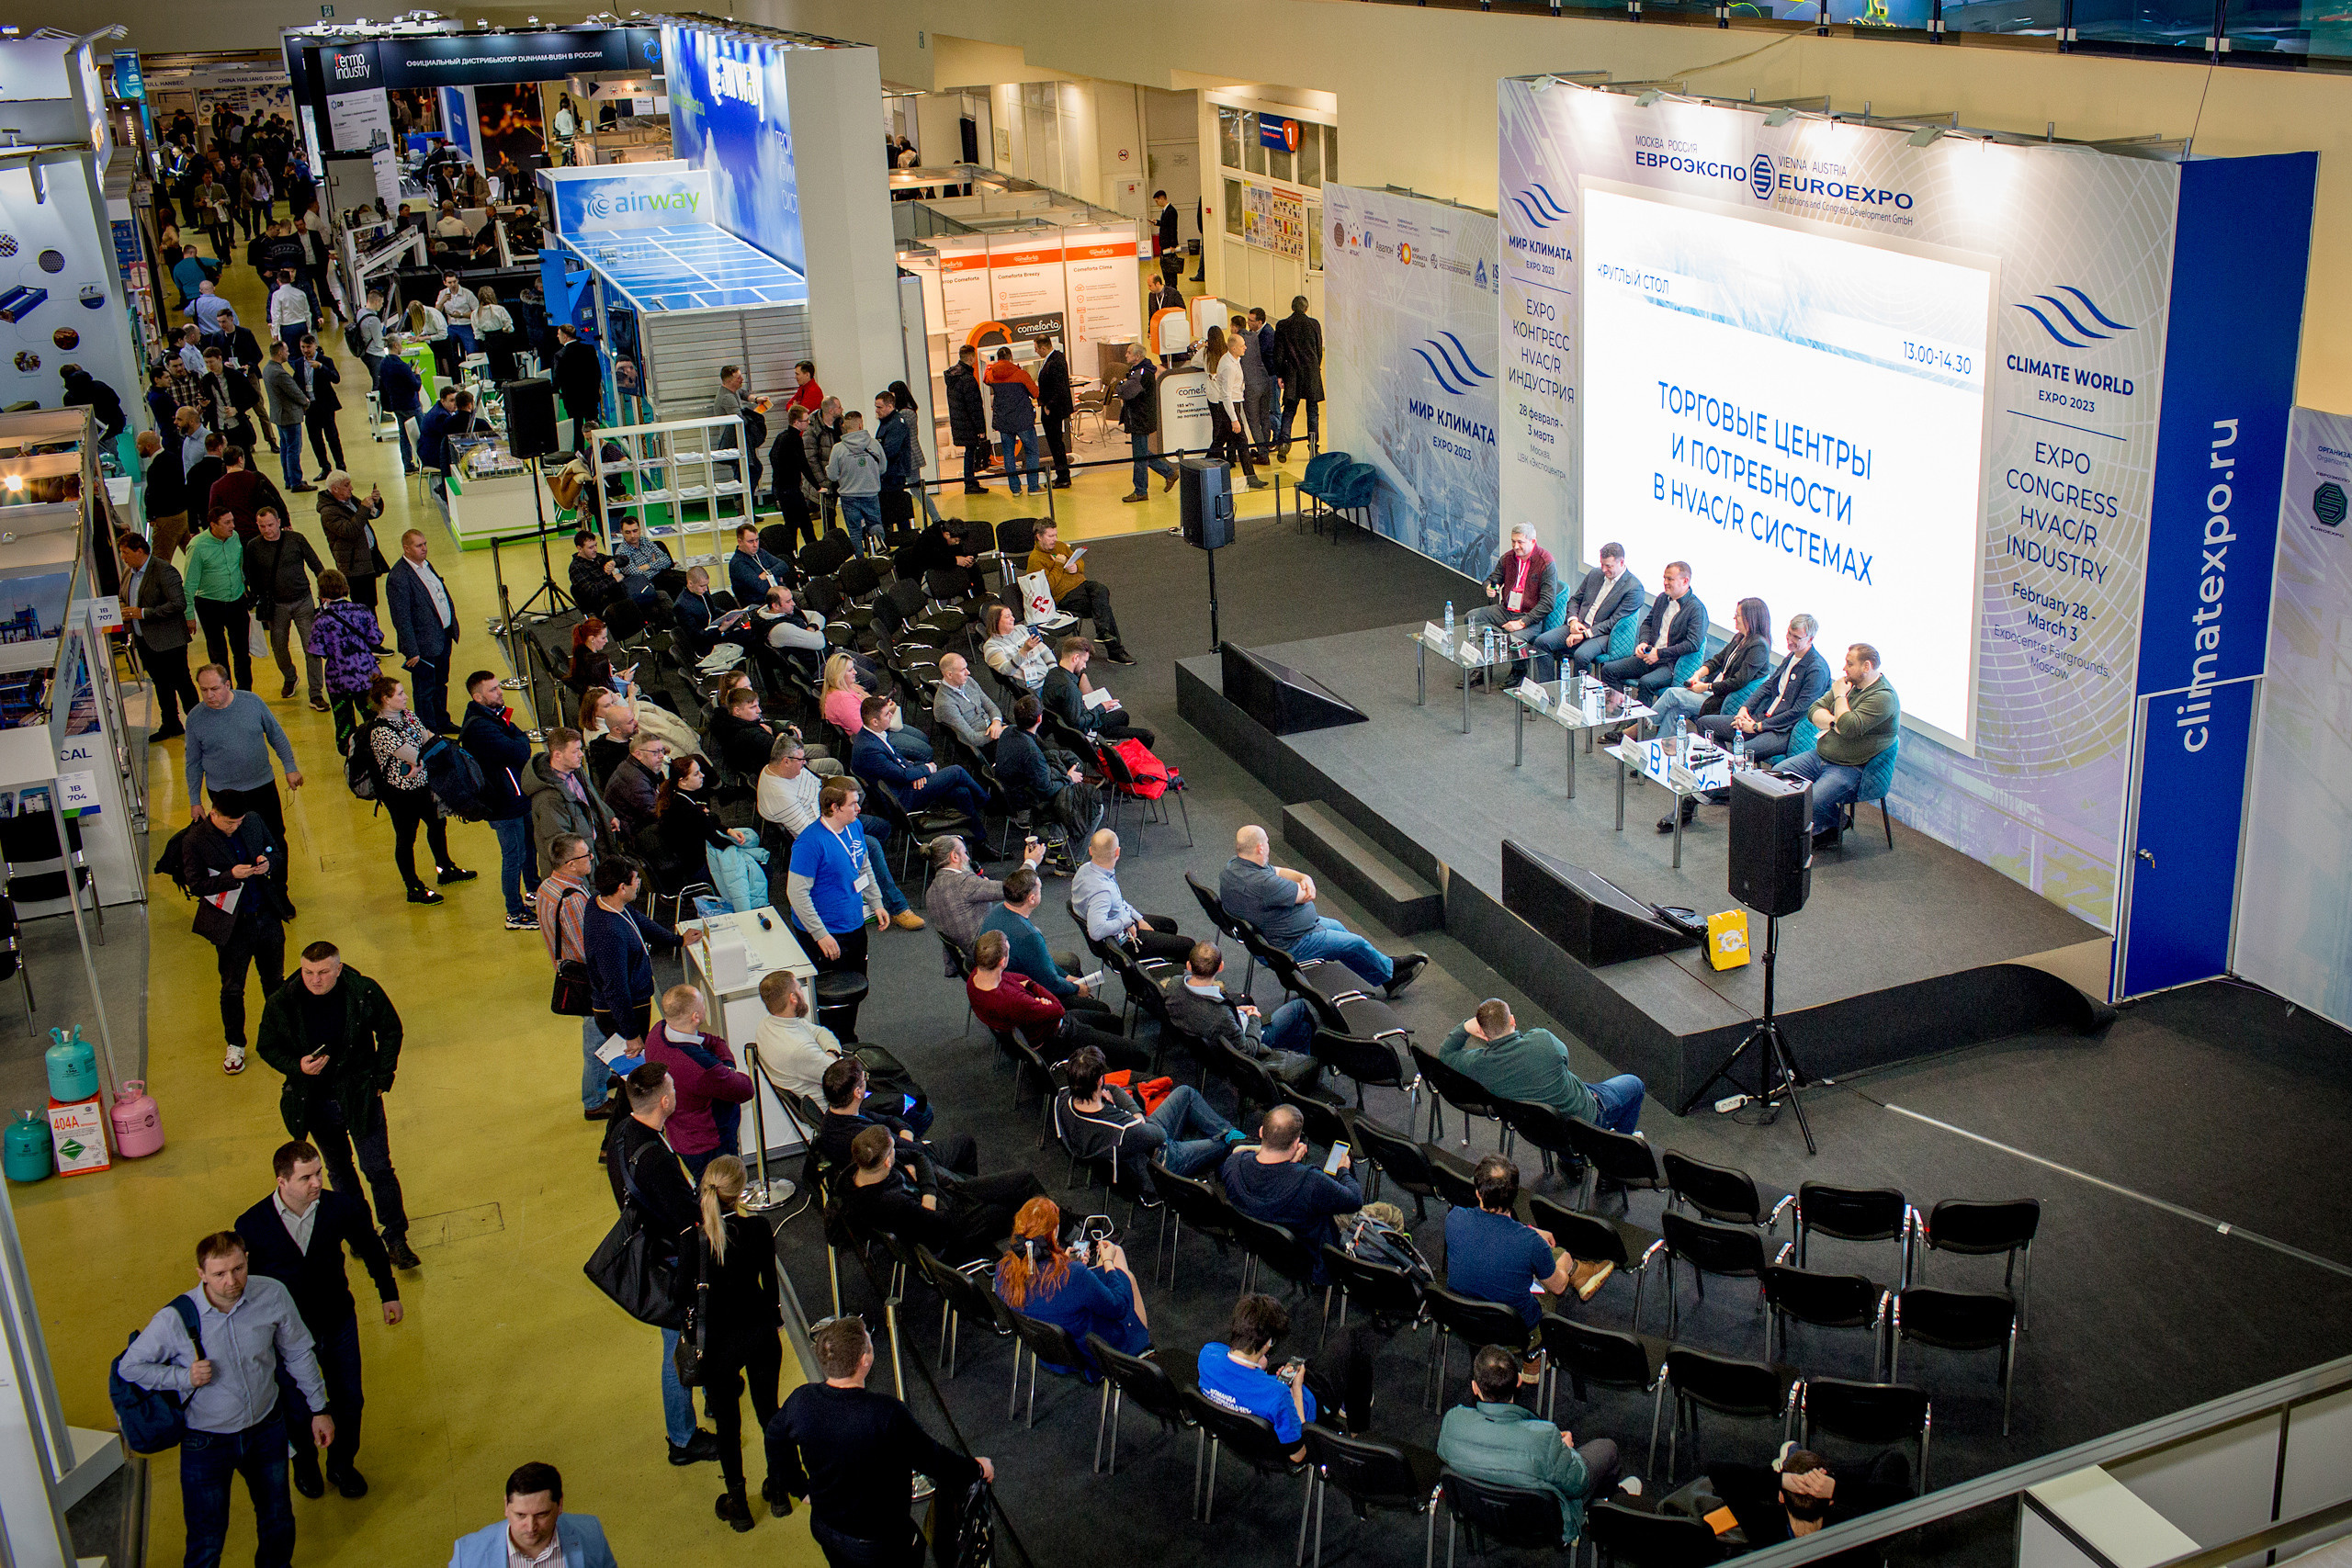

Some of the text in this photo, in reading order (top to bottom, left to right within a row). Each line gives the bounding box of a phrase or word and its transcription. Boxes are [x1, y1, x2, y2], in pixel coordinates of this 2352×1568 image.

[334, 53, 365, 68] termo
[335, 64, 370, 80] industry
[406, 57, 460, 67] ОФИЦИАЛЬНЫЙ
[461, 56, 517, 66] ДИСТРИБЬЮТОР
[518, 52, 567, 62] DUNHAM-BUSH
[1288, 127, 1292, 145] 1
[1635, 135, 1698, 153] МОСКВА РОССИЯ
[1635, 151, 1747, 182] ЕВРОЭКСПО
[1778, 155, 1848, 177] VIENNA AUSTRIA
[615, 191, 700, 213] airway
[1778, 174, 1914, 209] EUROEXPO
[1778, 193, 1914, 226] Exhibitions and Congress Development GmbH
[1509, 235, 1573, 262] МИР КЛИМАТА
[1526, 260, 1555, 275] EXPO 2023
[1597, 262, 1669, 294] КРУГЛЫЙ СТОЛ
[1527, 299, 1555, 321] EXPO
[1016, 319, 1061, 333] comeforta
[1513, 319, 1570, 351] КОНГРЕСС
[1521, 346, 1561, 374] HVAC/R
[1903, 341, 1972, 375] 13.00-14.30
[1509, 367, 1575, 404] ИНДУСТРИЯ
[2007, 354, 2134, 396] CLIMATE WORLD
[2038, 389, 2095, 412] EXPO 2023
[1409, 397, 1496, 447] МИР КЛИМАТА
[1519, 403, 1528, 416] 28
[1528, 407, 1559, 428] февраля
[1527, 424, 1555, 444] 3 марта
[1658, 380, 1871, 480] ТОРГОВЫЕ ЦЕНТРЫ
[1432, 436, 1472, 461] EXPO 2023
[1530, 444, 1551, 461] Москва,
[2035, 441, 2091, 475] EXPO
[1672, 432, 1852, 526] И ПОТРЕБНОСТИ
[2316, 471, 2351, 484] ЕВРОЭКСПО
[2006, 468, 2118, 518] CONGRESS
[1654, 472, 1873, 586] В HVAC/R СИСТЕМАХ
[2020, 505, 2098, 548] HVAC/R
[2310, 525, 2345, 538] EUROEXPO
[2007, 534, 2109, 584] INDUSTRY
[2176, 417, 2239, 753] climatexpo.ru
[2013, 582, 2069, 617] February
[2072, 603, 2088, 621] 28
[2027, 610, 2078, 642] March 3
[1994, 624, 2110, 679] Expocentre Fairgrounds,
[2030, 656, 2069, 681] Moscow
[60, 747, 93, 762] CAL
[68, 793, 87, 802] 704
[54, 1115, 80, 1131] 404A
[1210, 1388, 1236, 1404] КОМАНДА
